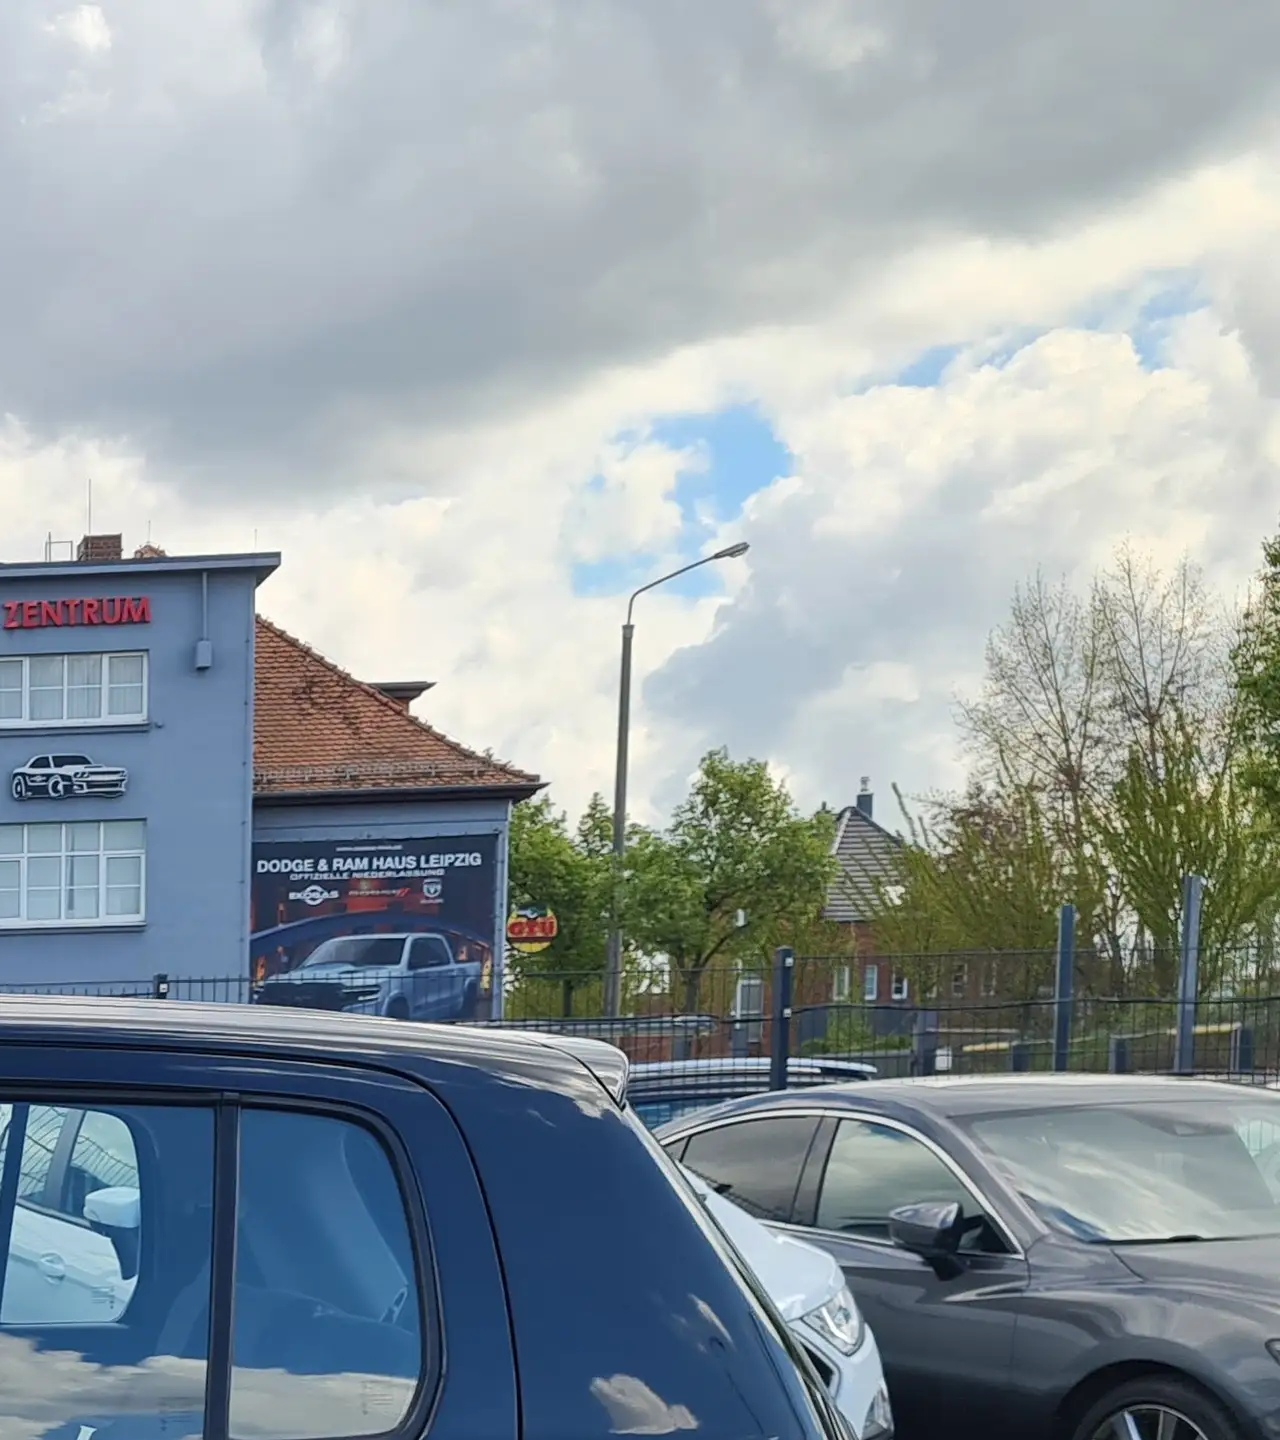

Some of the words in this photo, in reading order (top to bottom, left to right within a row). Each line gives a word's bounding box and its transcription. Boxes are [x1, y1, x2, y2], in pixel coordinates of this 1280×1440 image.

[3, 597, 152, 629] ZENTRUM
[256, 859, 314, 873] DODGE
[317, 858, 329, 872] &
[332, 857, 369, 871] RAM
[372, 855, 417, 869] HAUS
[420, 852, 482, 868] LEIPZIG
[290, 872, 349, 881] OFFIZIELLE
[352, 869, 445, 879] NIEDERLASSUNG
